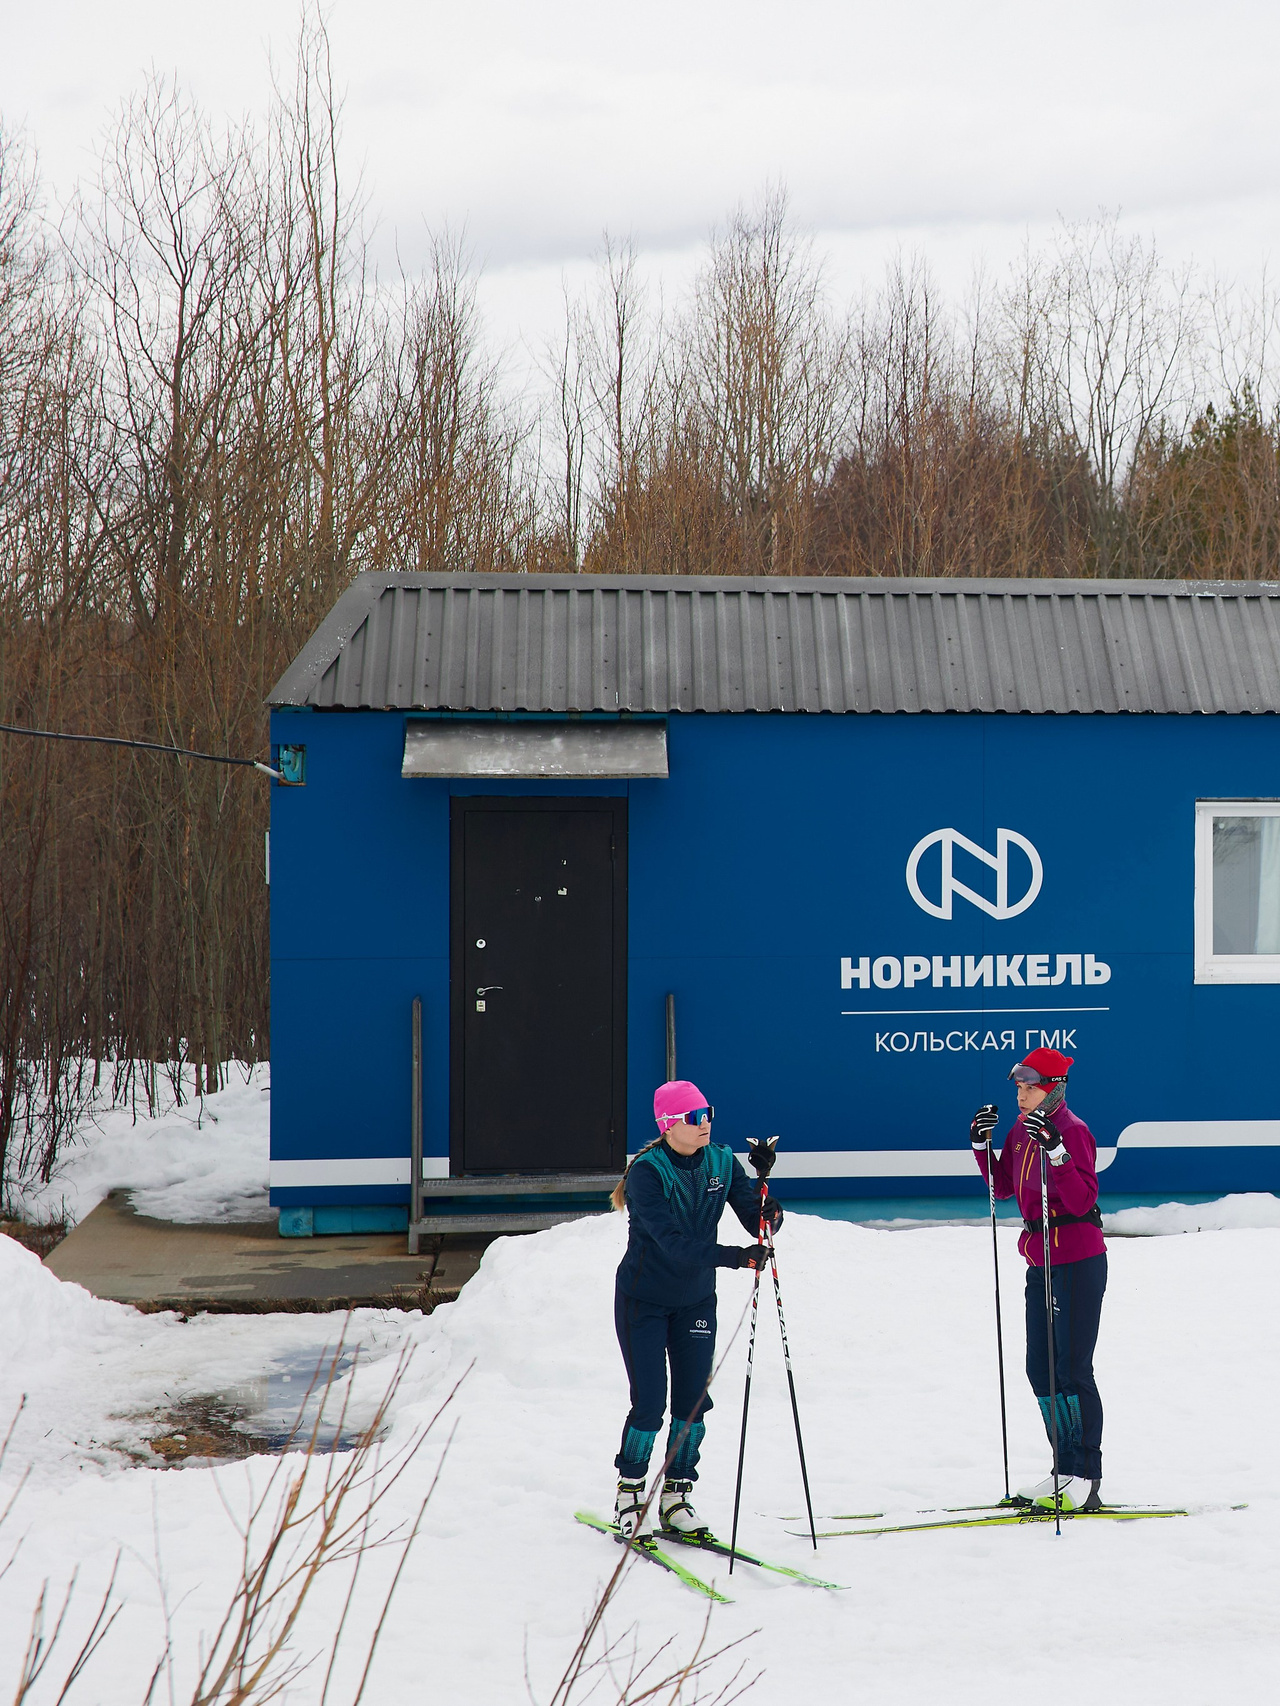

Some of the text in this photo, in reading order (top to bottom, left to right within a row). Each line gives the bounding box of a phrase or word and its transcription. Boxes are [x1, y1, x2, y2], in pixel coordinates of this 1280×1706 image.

[840, 953, 1112, 990] НОРНИКЕЛЬ
[875, 1028, 1078, 1053] КОЛЬСКАЯ ГМК
